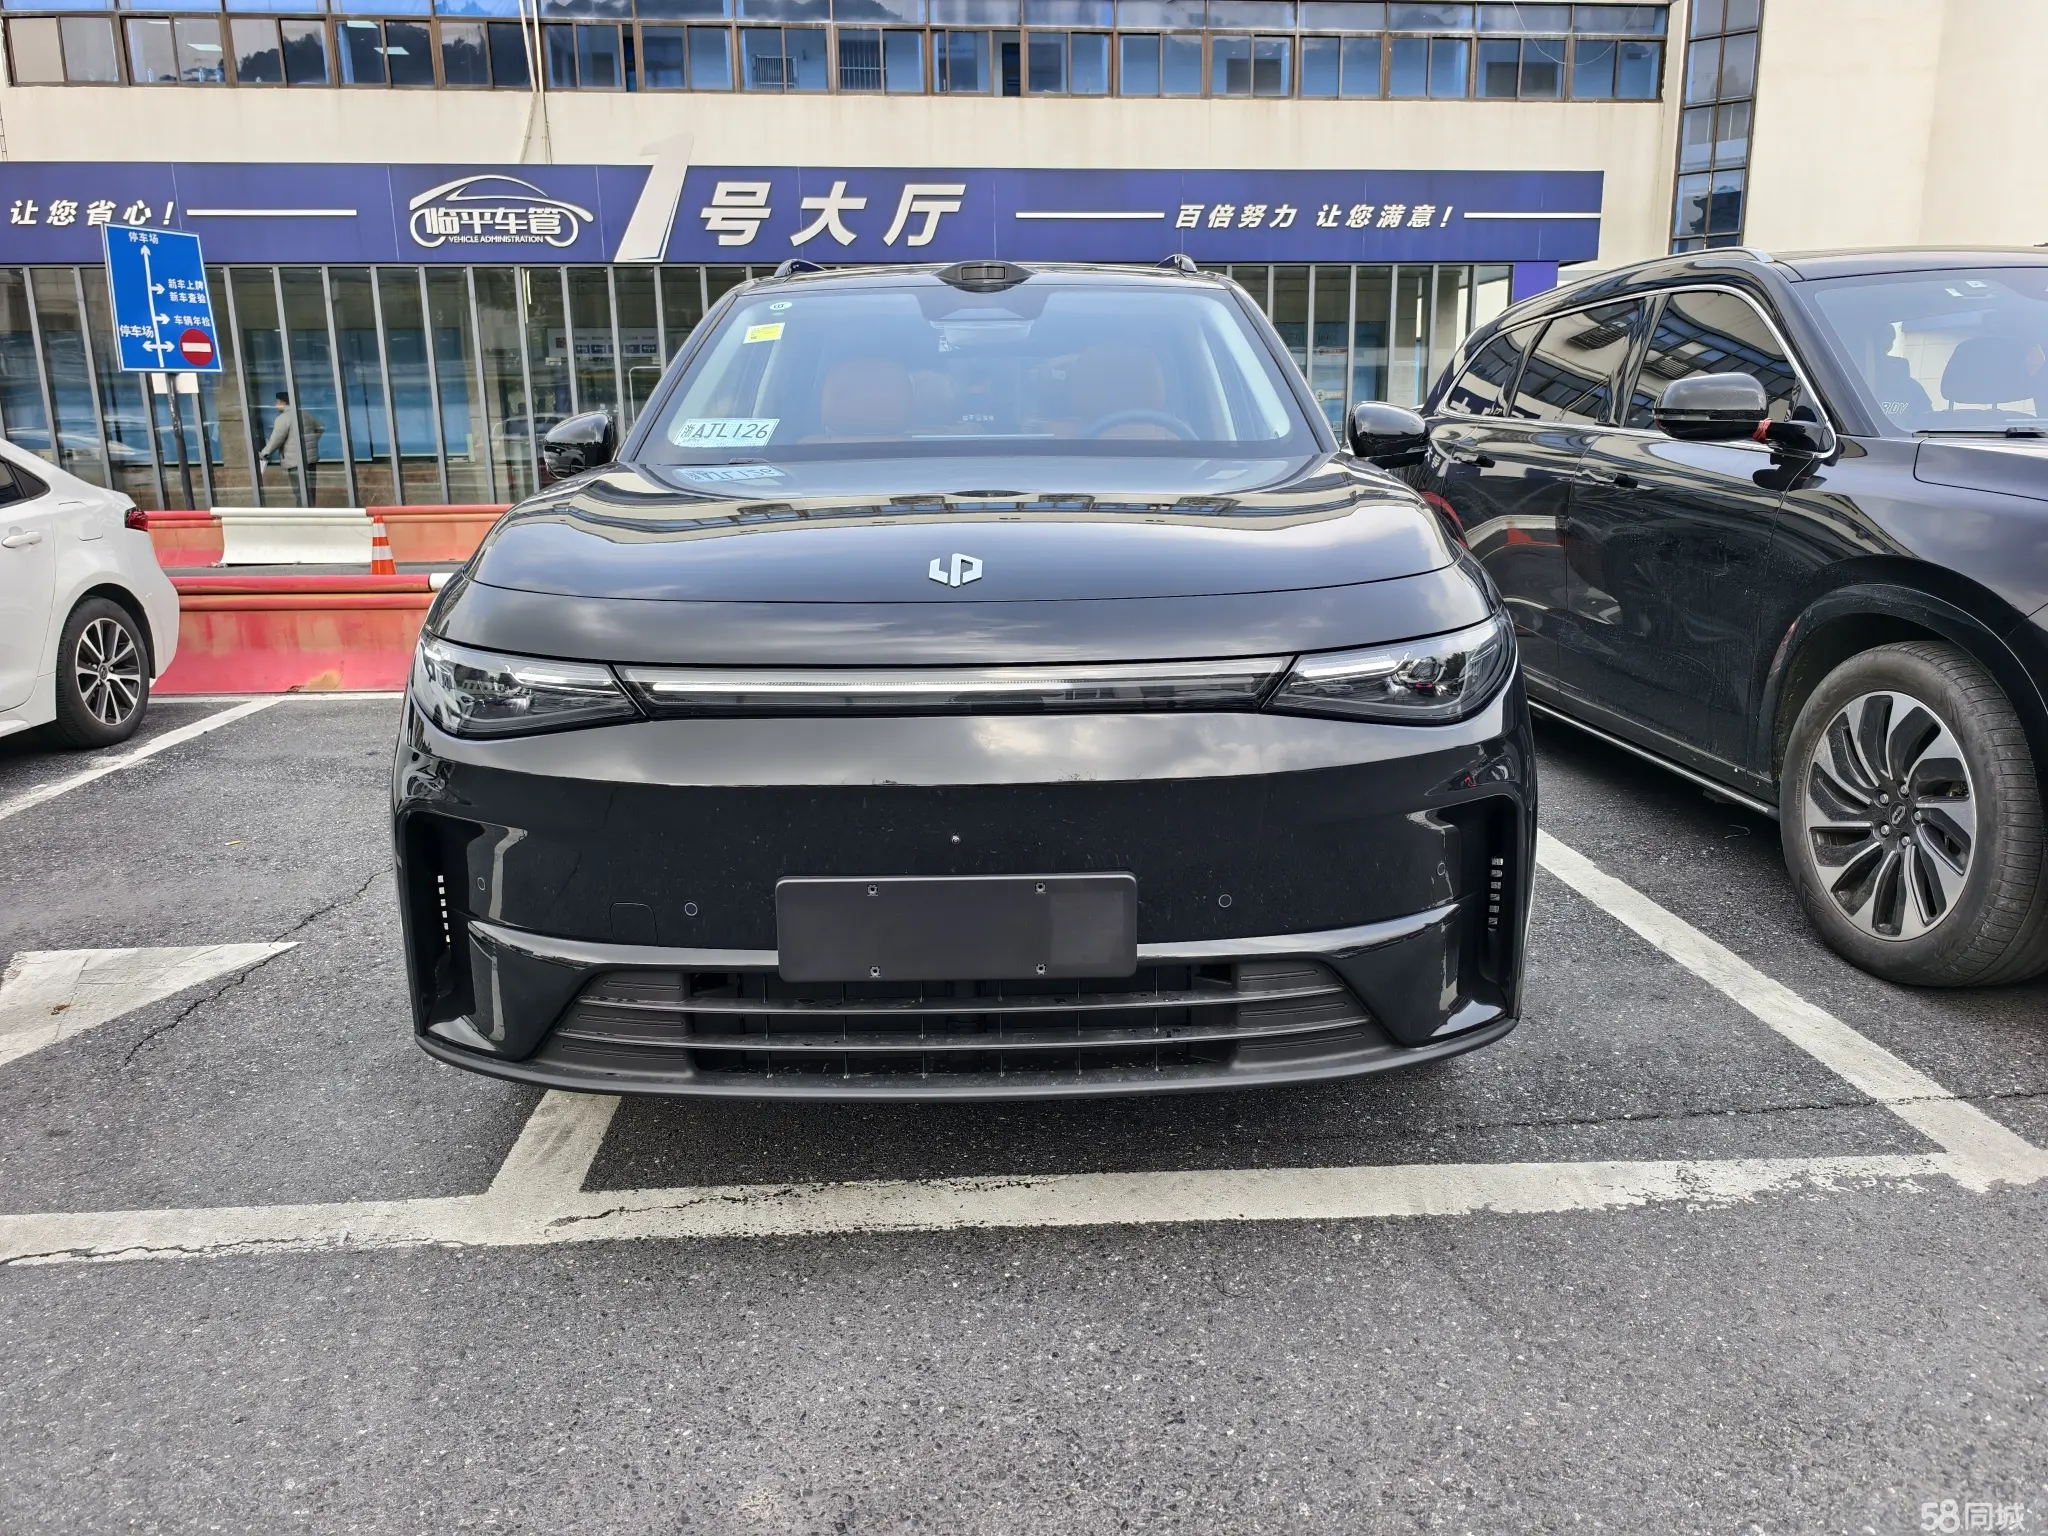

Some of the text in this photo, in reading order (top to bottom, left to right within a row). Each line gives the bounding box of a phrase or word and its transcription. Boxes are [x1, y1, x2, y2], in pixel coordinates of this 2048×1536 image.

[613, 132, 966, 263] 1号大厅
[424, 207, 561, 235] 临平车管
[1175, 204, 1453, 229] 百倍努力 让您满意!
[128, 231, 159, 244] 停车场
[168, 278, 204, 291] 新车上牌
[169, 291, 206, 304] 新车查验
[173, 314, 212, 327] 车辆年检
[119, 324, 154, 338] 停车场
